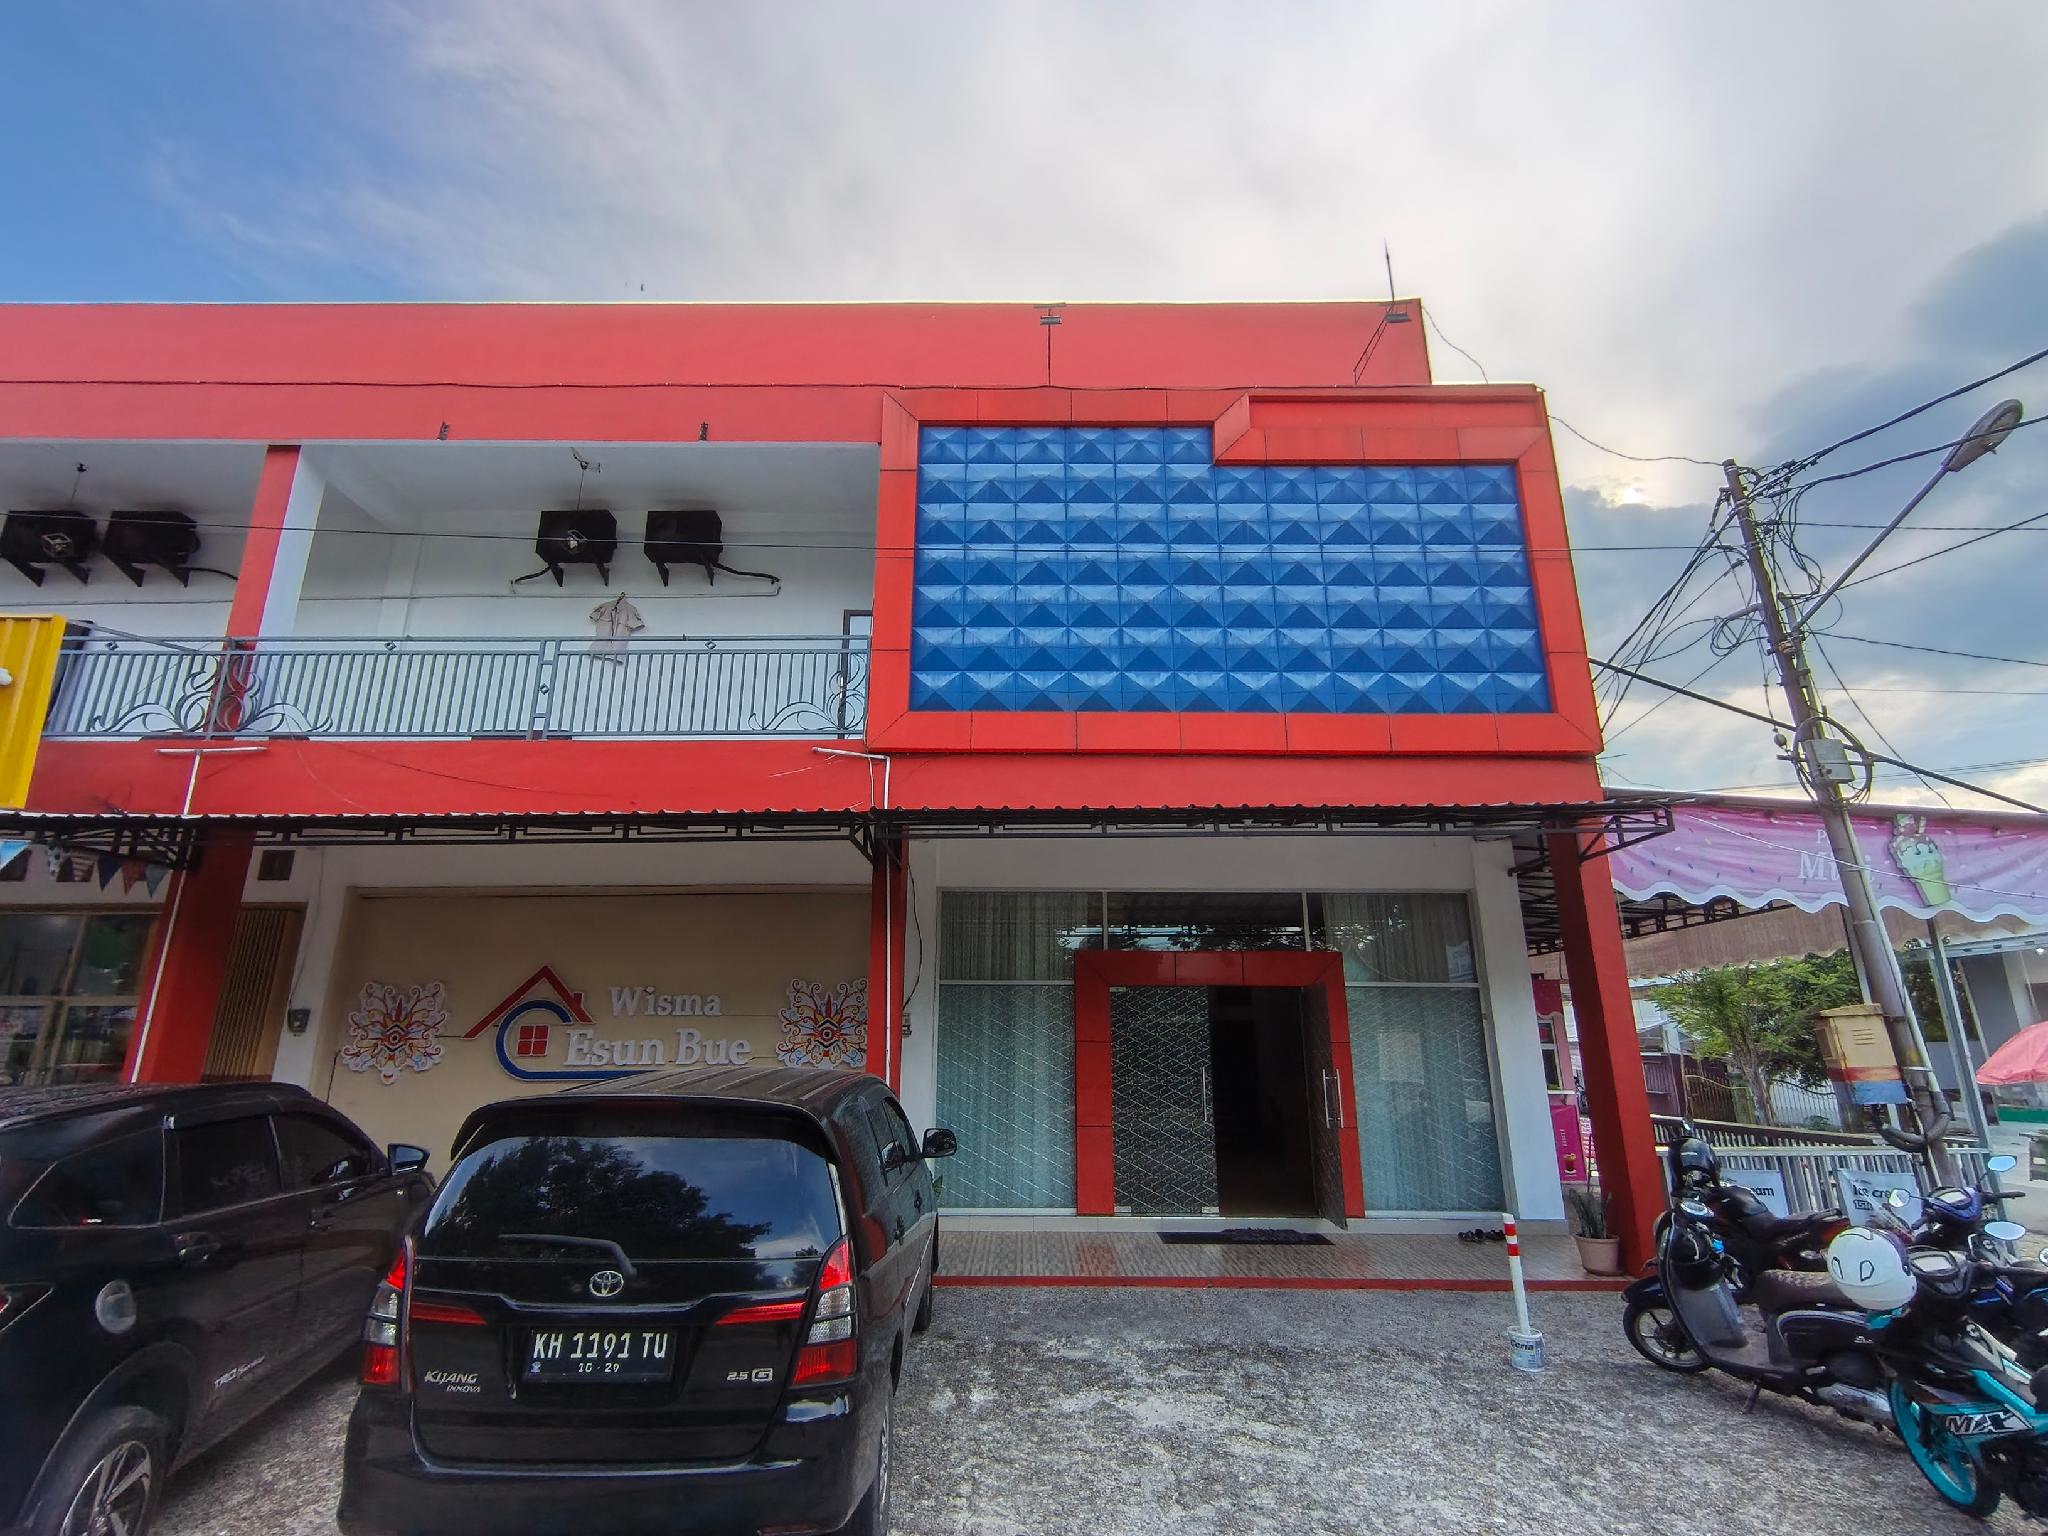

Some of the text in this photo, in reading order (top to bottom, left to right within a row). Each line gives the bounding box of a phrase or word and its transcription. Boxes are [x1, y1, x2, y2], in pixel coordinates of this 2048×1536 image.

[608, 986, 722, 1016] Wisma
[563, 1028, 752, 1065] Esun Bue
[533, 1332, 668, 1359] KH 1191 TU
[424, 1370, 478, 1384] KIJANG
